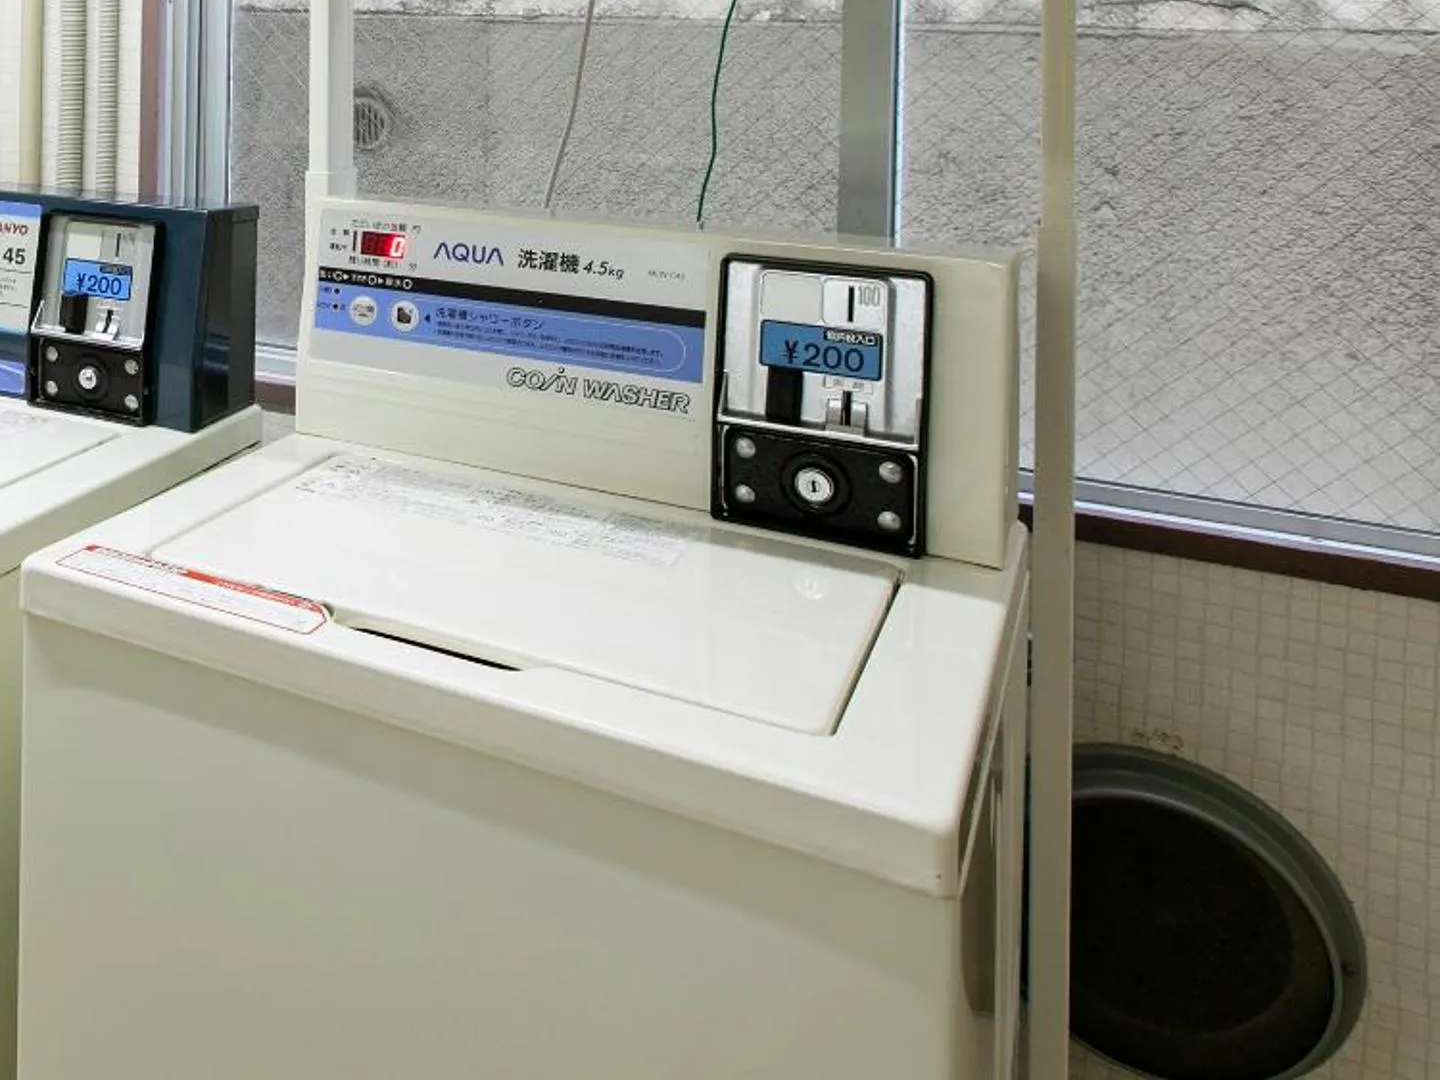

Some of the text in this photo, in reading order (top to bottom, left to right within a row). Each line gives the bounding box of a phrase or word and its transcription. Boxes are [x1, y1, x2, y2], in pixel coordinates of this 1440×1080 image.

[3, 247, 27, 265] 45
[390, 236, 406, 258] 0
[433, 241, 625, 280] AQUA 洗濯機 4.5kg
[77, 272, 122, 295] ¥200
[858, 286, 881, 307] 100
[783, 338, 865, 373] ¥200
[582, 378, 692, 414] WASHER
